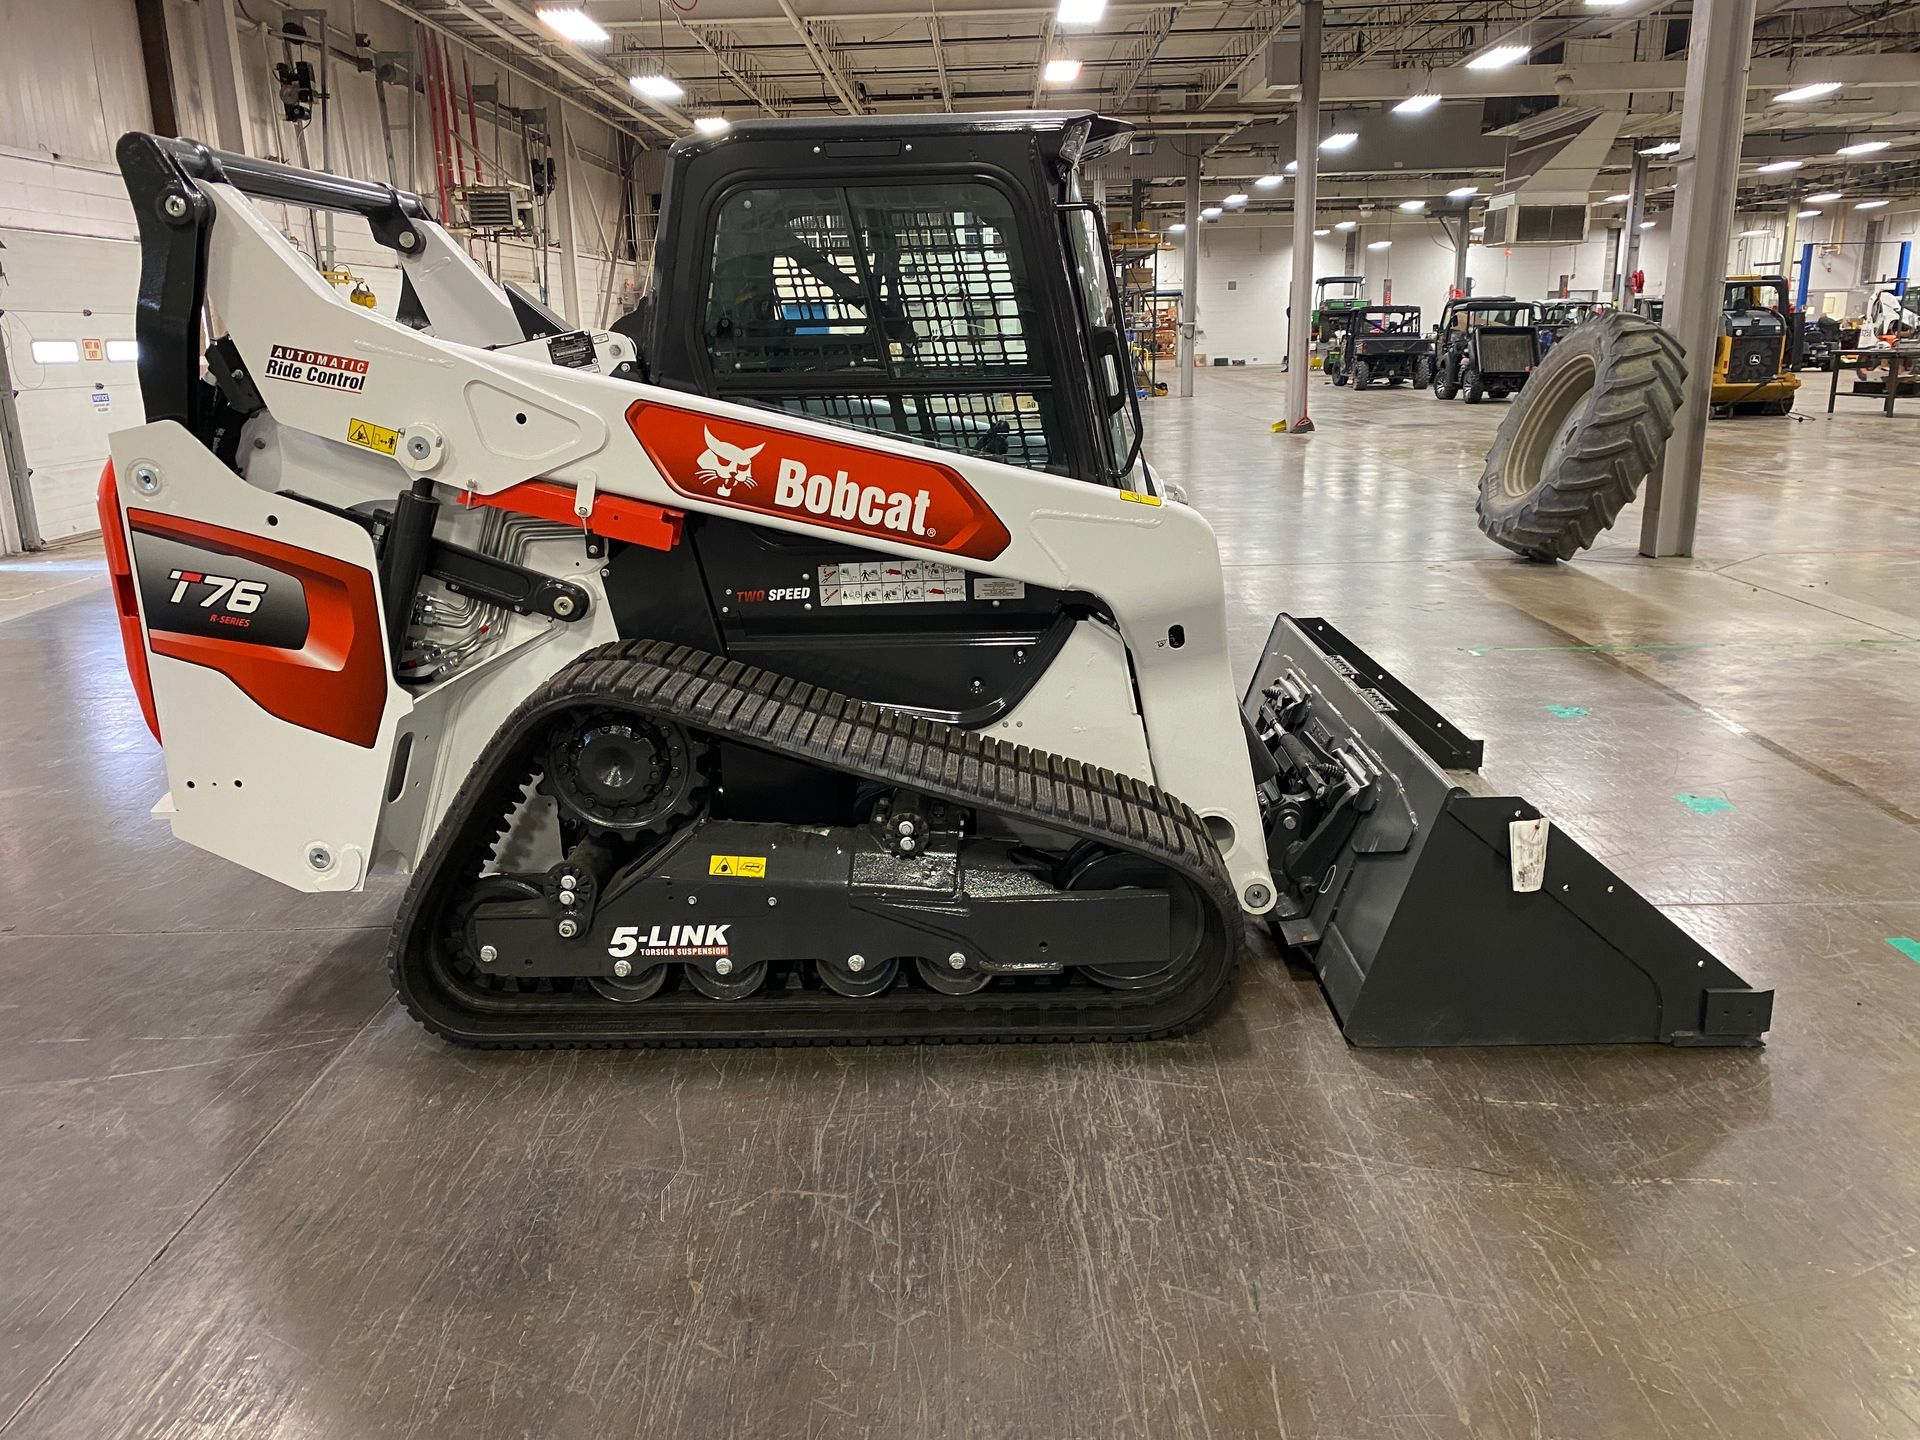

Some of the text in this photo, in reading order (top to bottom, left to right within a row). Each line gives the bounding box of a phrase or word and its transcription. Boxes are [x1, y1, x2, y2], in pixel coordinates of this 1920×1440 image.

[274, 347, 366, 372] AUTOMATIC
[265, 359, 366, 391] Ride Control
[774, 457, 931, 536] Bobcat
[169, 570, 268, 614] T76
[736, 587, 811, 602] TWO SPEED
[209, 614, 251, 627] R-SERIES
[607, 924, 732, 958] 5-LINK
[640, 947, 727, 956] TORSION SUSPENSION
